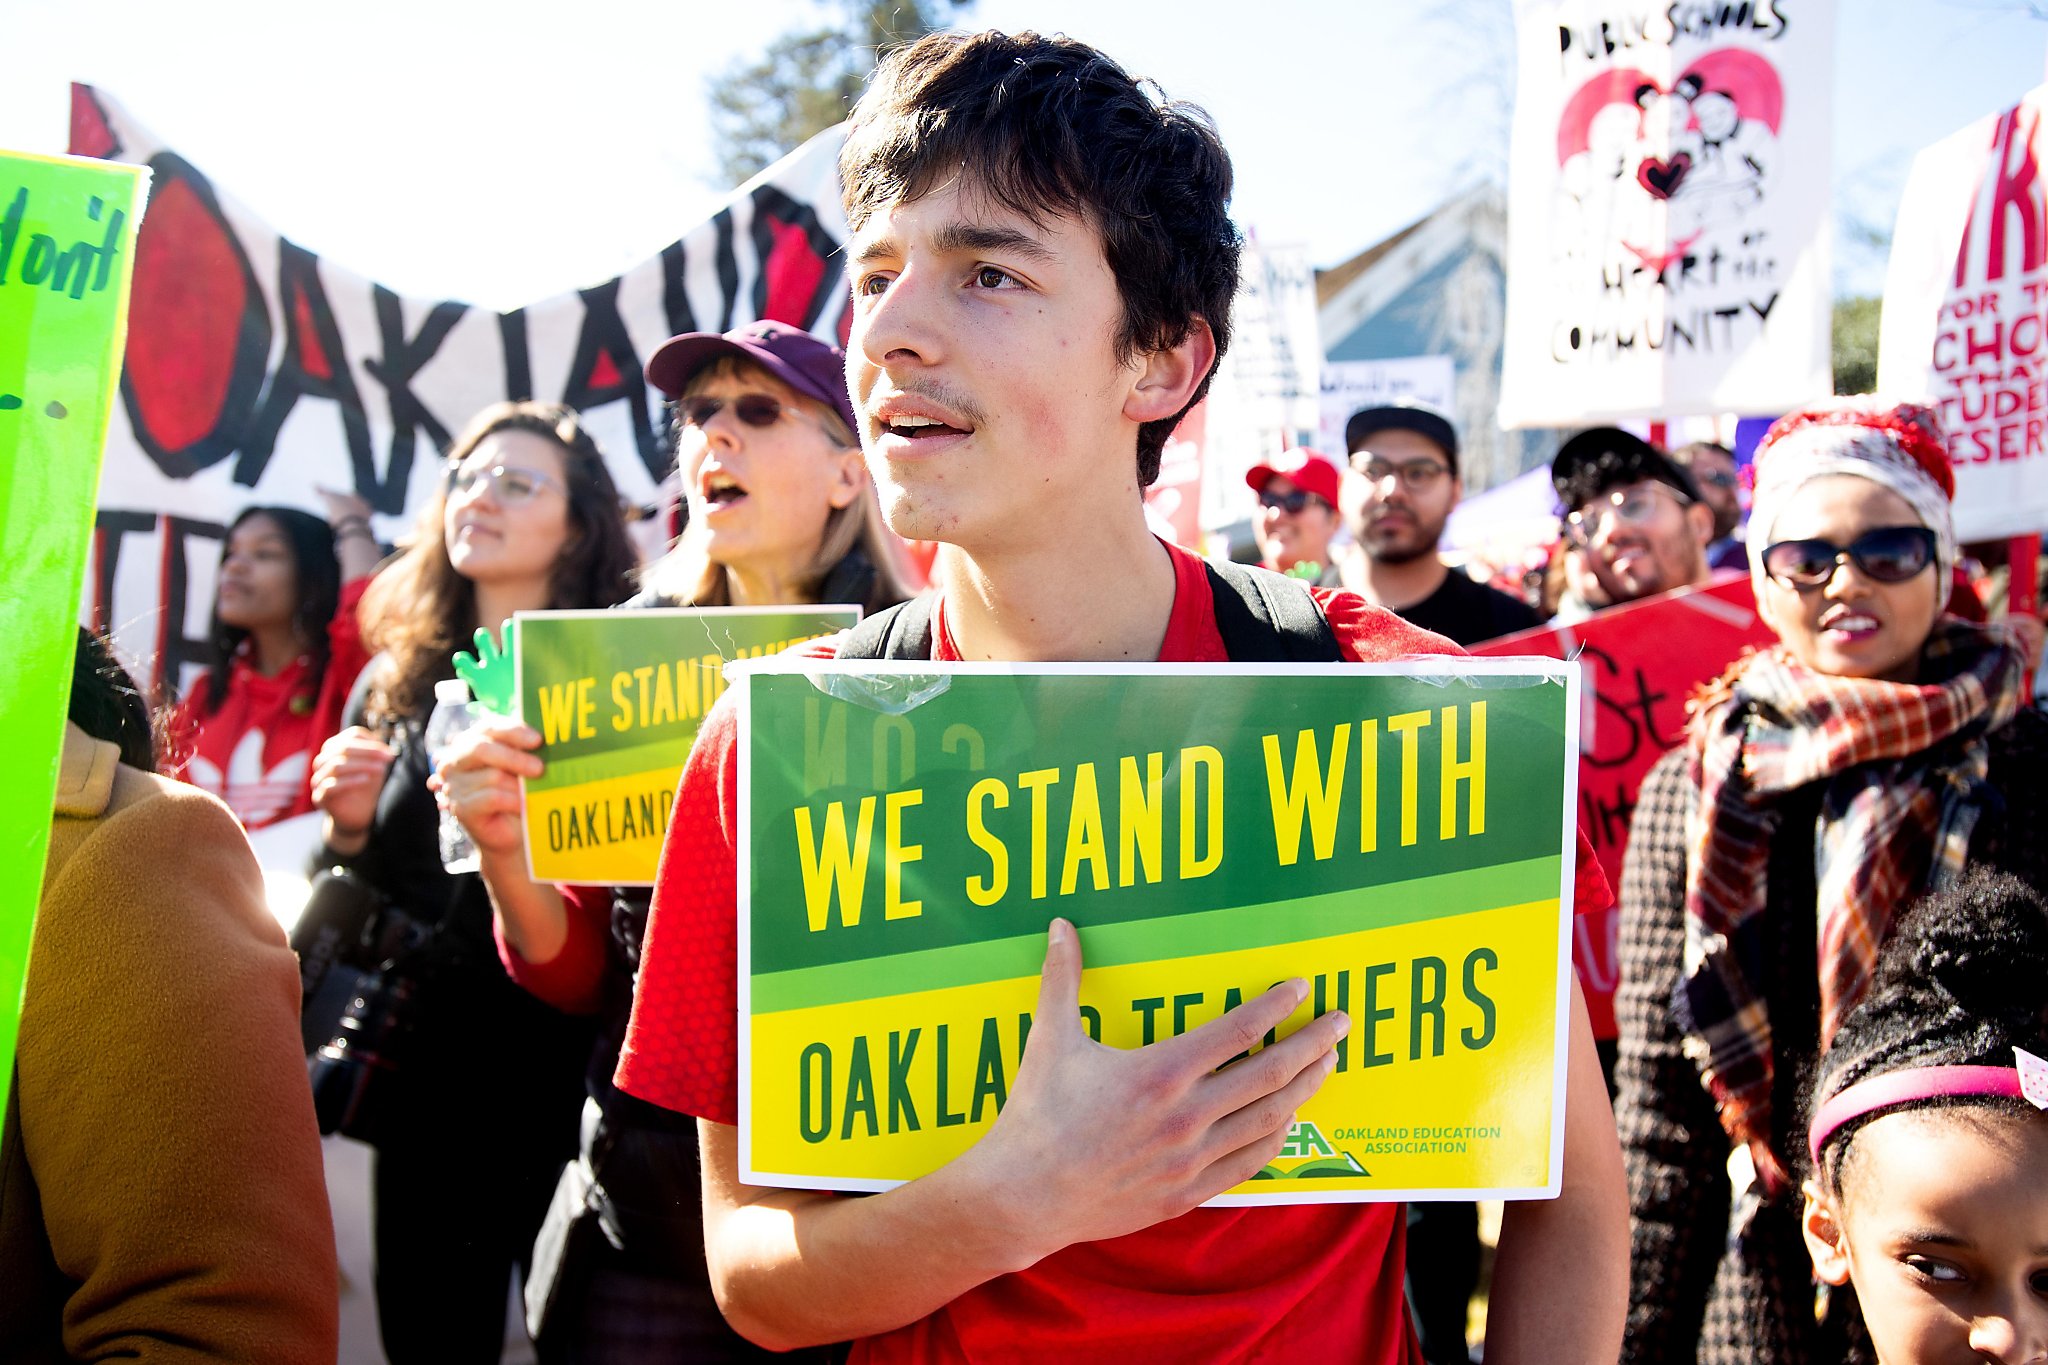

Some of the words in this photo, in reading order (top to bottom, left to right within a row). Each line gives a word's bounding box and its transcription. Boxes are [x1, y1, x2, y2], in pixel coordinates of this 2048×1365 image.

[1552, 289, 1782, 362] COMMUNITY
[1933, 313, 2048, 371] CHO
[1941, 383, 2048, 424] TUDE
[539, 677, 597, 746] WE
[611, 653, 727, 732] STAND
[548, 790, 674, 852] OAKLAND
[794, 789, 923, 932] WE
[966, 745, 1224, 906] STAND
[1262, 701, 1487, 866] WITH
[800, 1006, 1101, 1144] OAKLA
[1132, 947, 1498, 1079] THERS
[1333, 1127, 1408, 1140] OAKLAND
[1413, 1127, 1501, 1140] EDUCATION
[1364, 1141, 1467, 1155] ASSOCIATION
